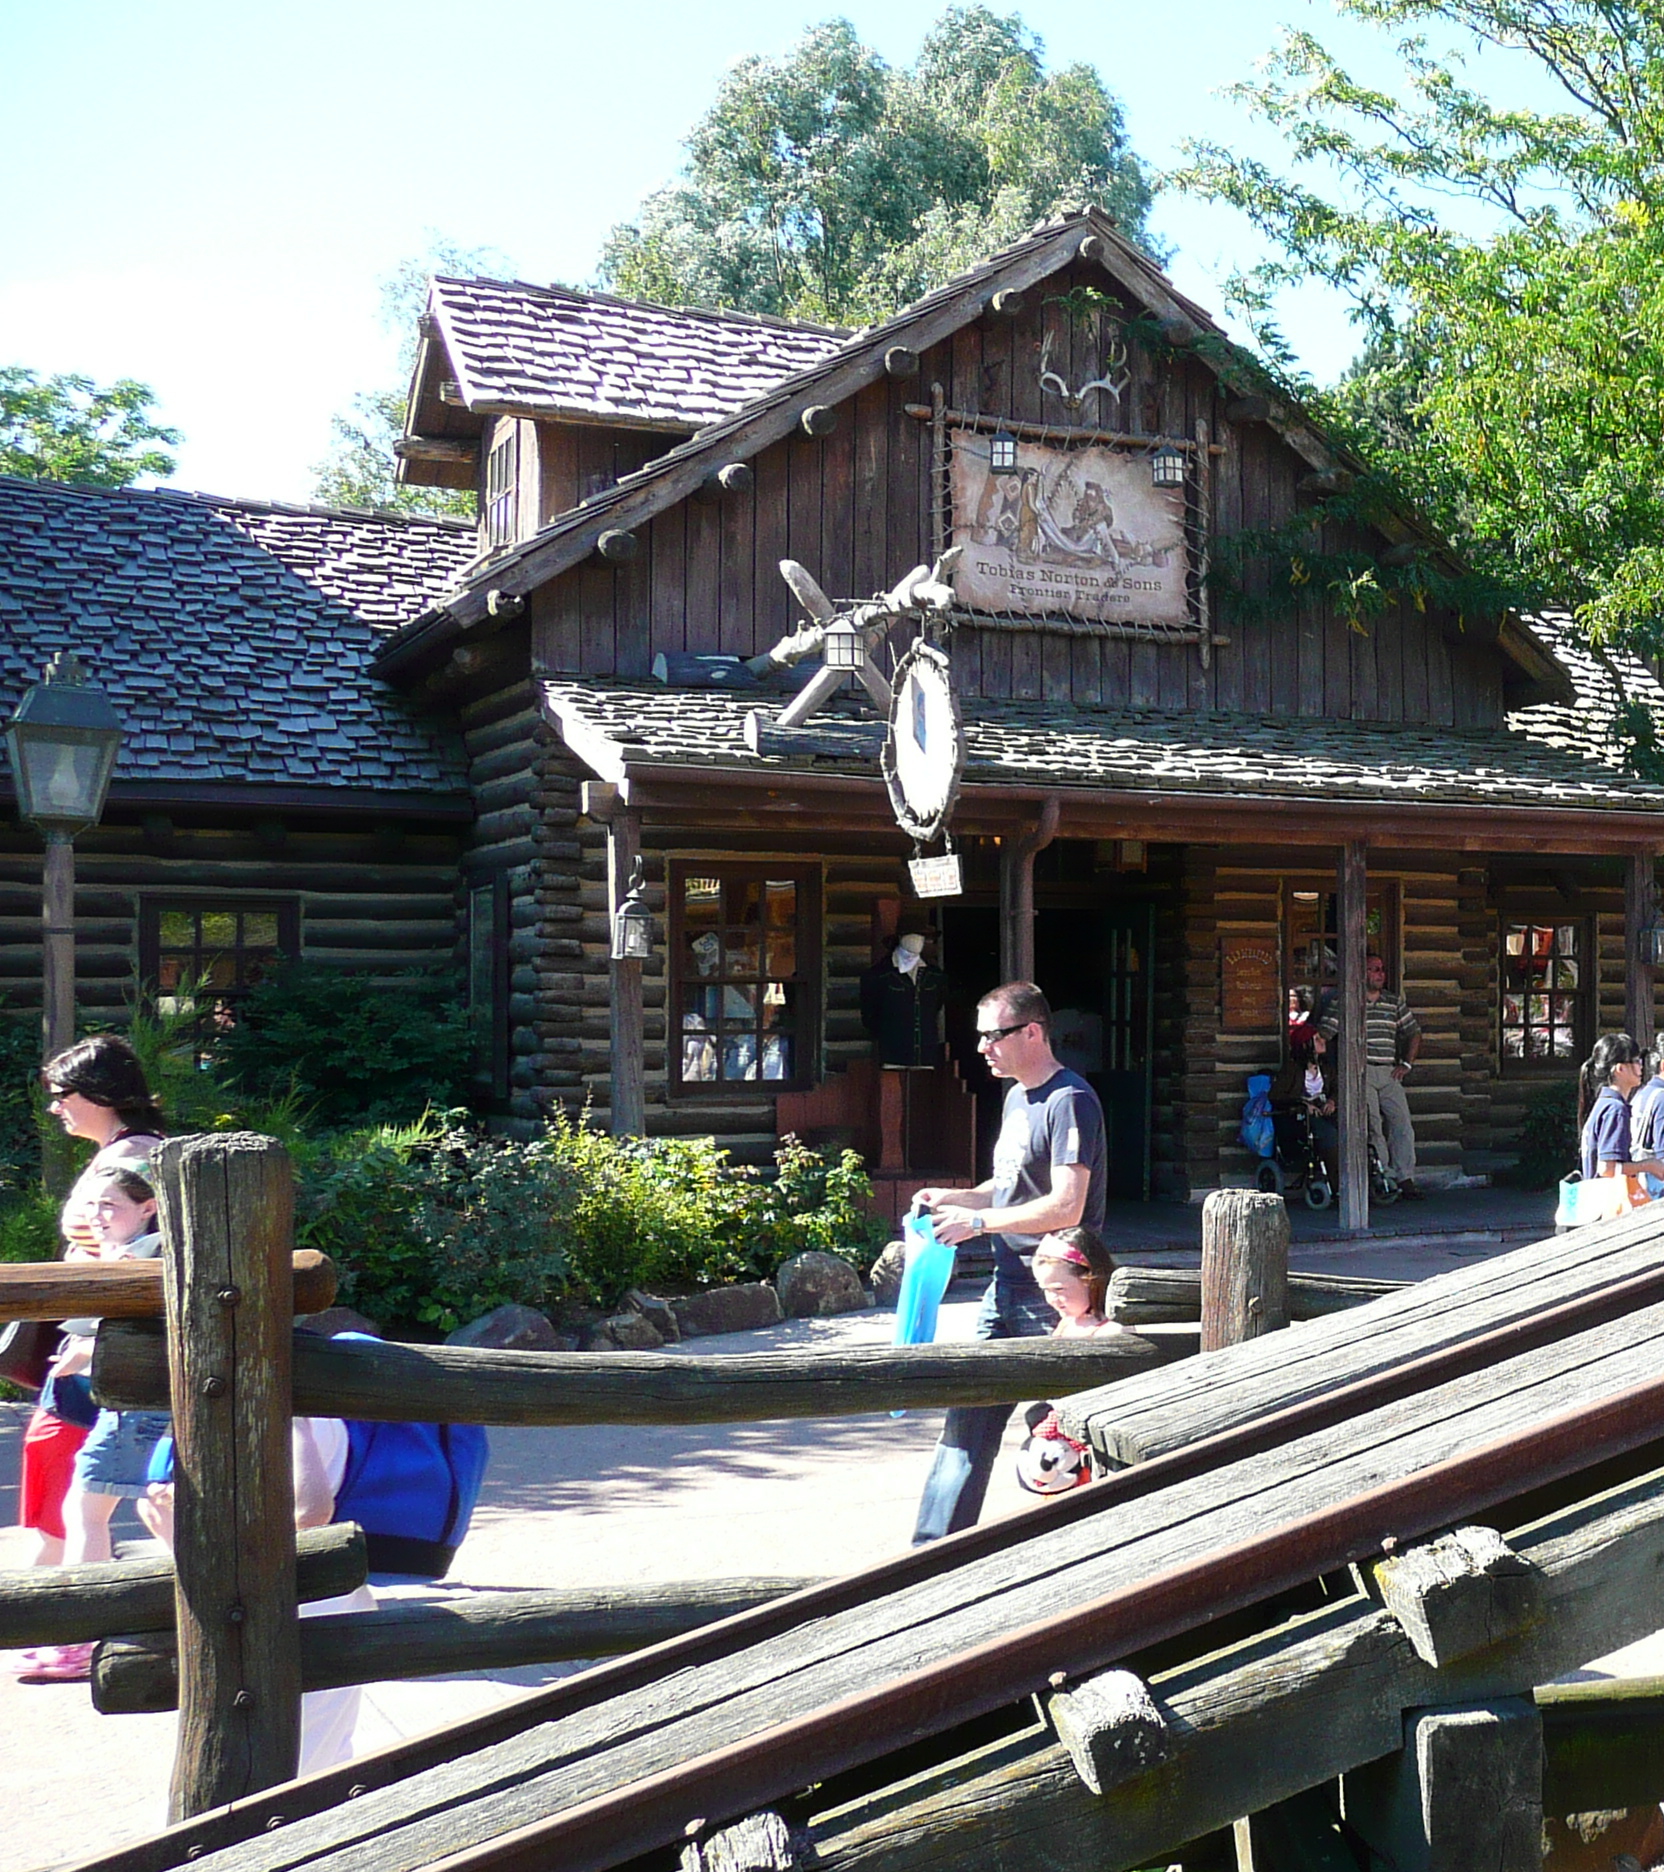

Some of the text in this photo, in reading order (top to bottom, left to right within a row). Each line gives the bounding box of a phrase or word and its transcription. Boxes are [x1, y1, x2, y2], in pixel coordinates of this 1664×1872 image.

[976, 561, 1162, 592] Tobias Norton & Sons
[1009, 583, 1130, 604] Frontier Traders
